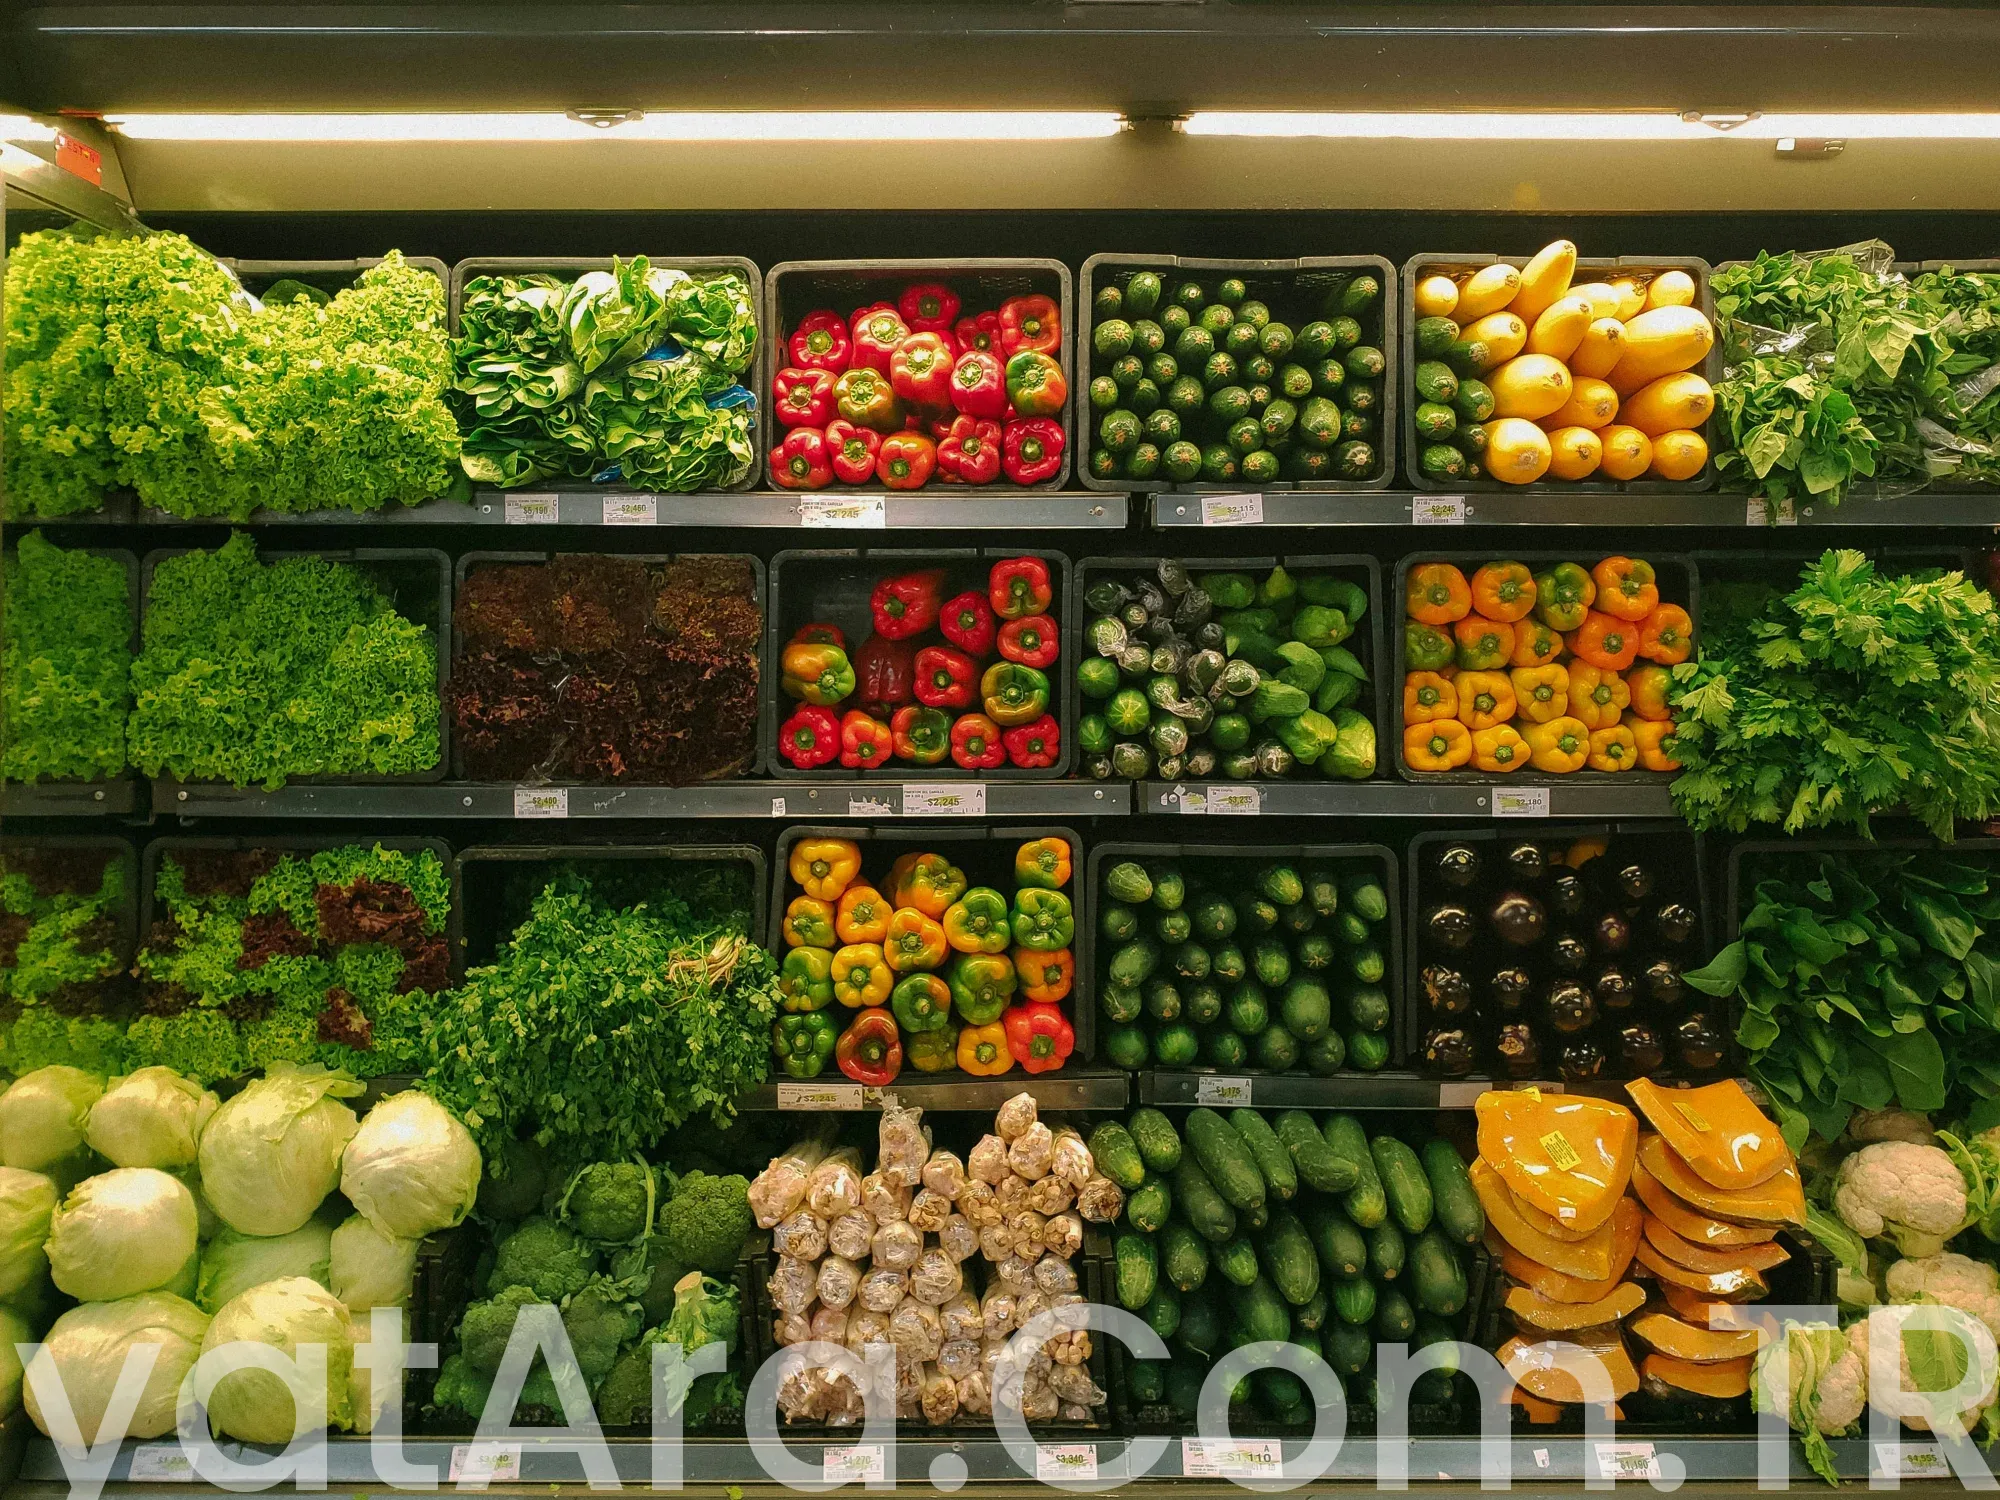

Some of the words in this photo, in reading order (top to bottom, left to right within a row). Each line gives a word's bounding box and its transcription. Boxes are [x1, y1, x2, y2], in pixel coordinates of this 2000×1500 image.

[875, 501, 884, 511] A
[1431, 505, 1456, 513] $2,245
[975, 789, 983, 798] A
[927, 797, 960, 807] $2,245
[803, 1095, 837, 1103] $2,245
